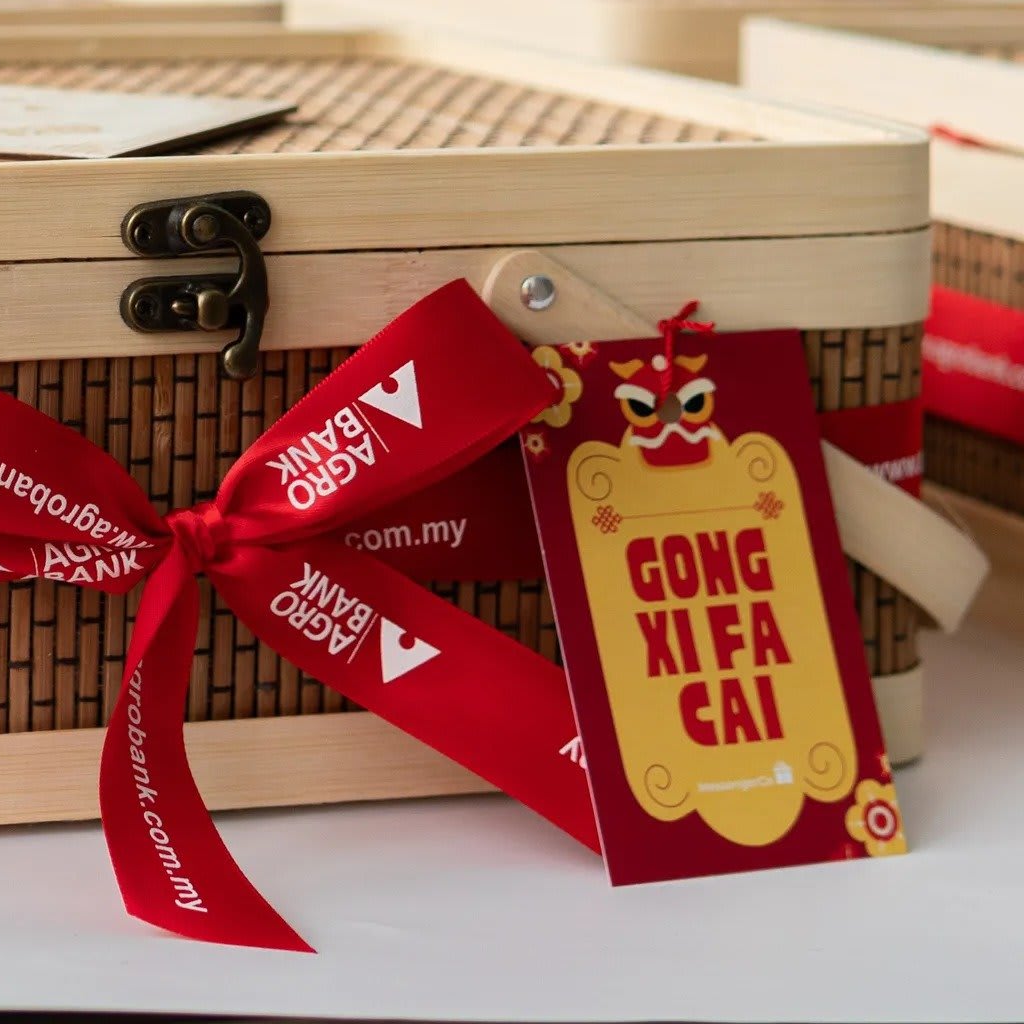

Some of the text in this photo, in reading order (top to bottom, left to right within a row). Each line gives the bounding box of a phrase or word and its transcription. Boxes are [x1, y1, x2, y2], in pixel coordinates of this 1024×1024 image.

[265, 406, 365, 485] BANK
[286, 432, 376, 510] AGRO
[289, 561, 374, 635] BANK
[626, 527, 774, 602] GONG
[269, 590, 357, 656] AGRO
[635, 600, 793, 678] XI FA
[678, 674, 784, 747] CAI
